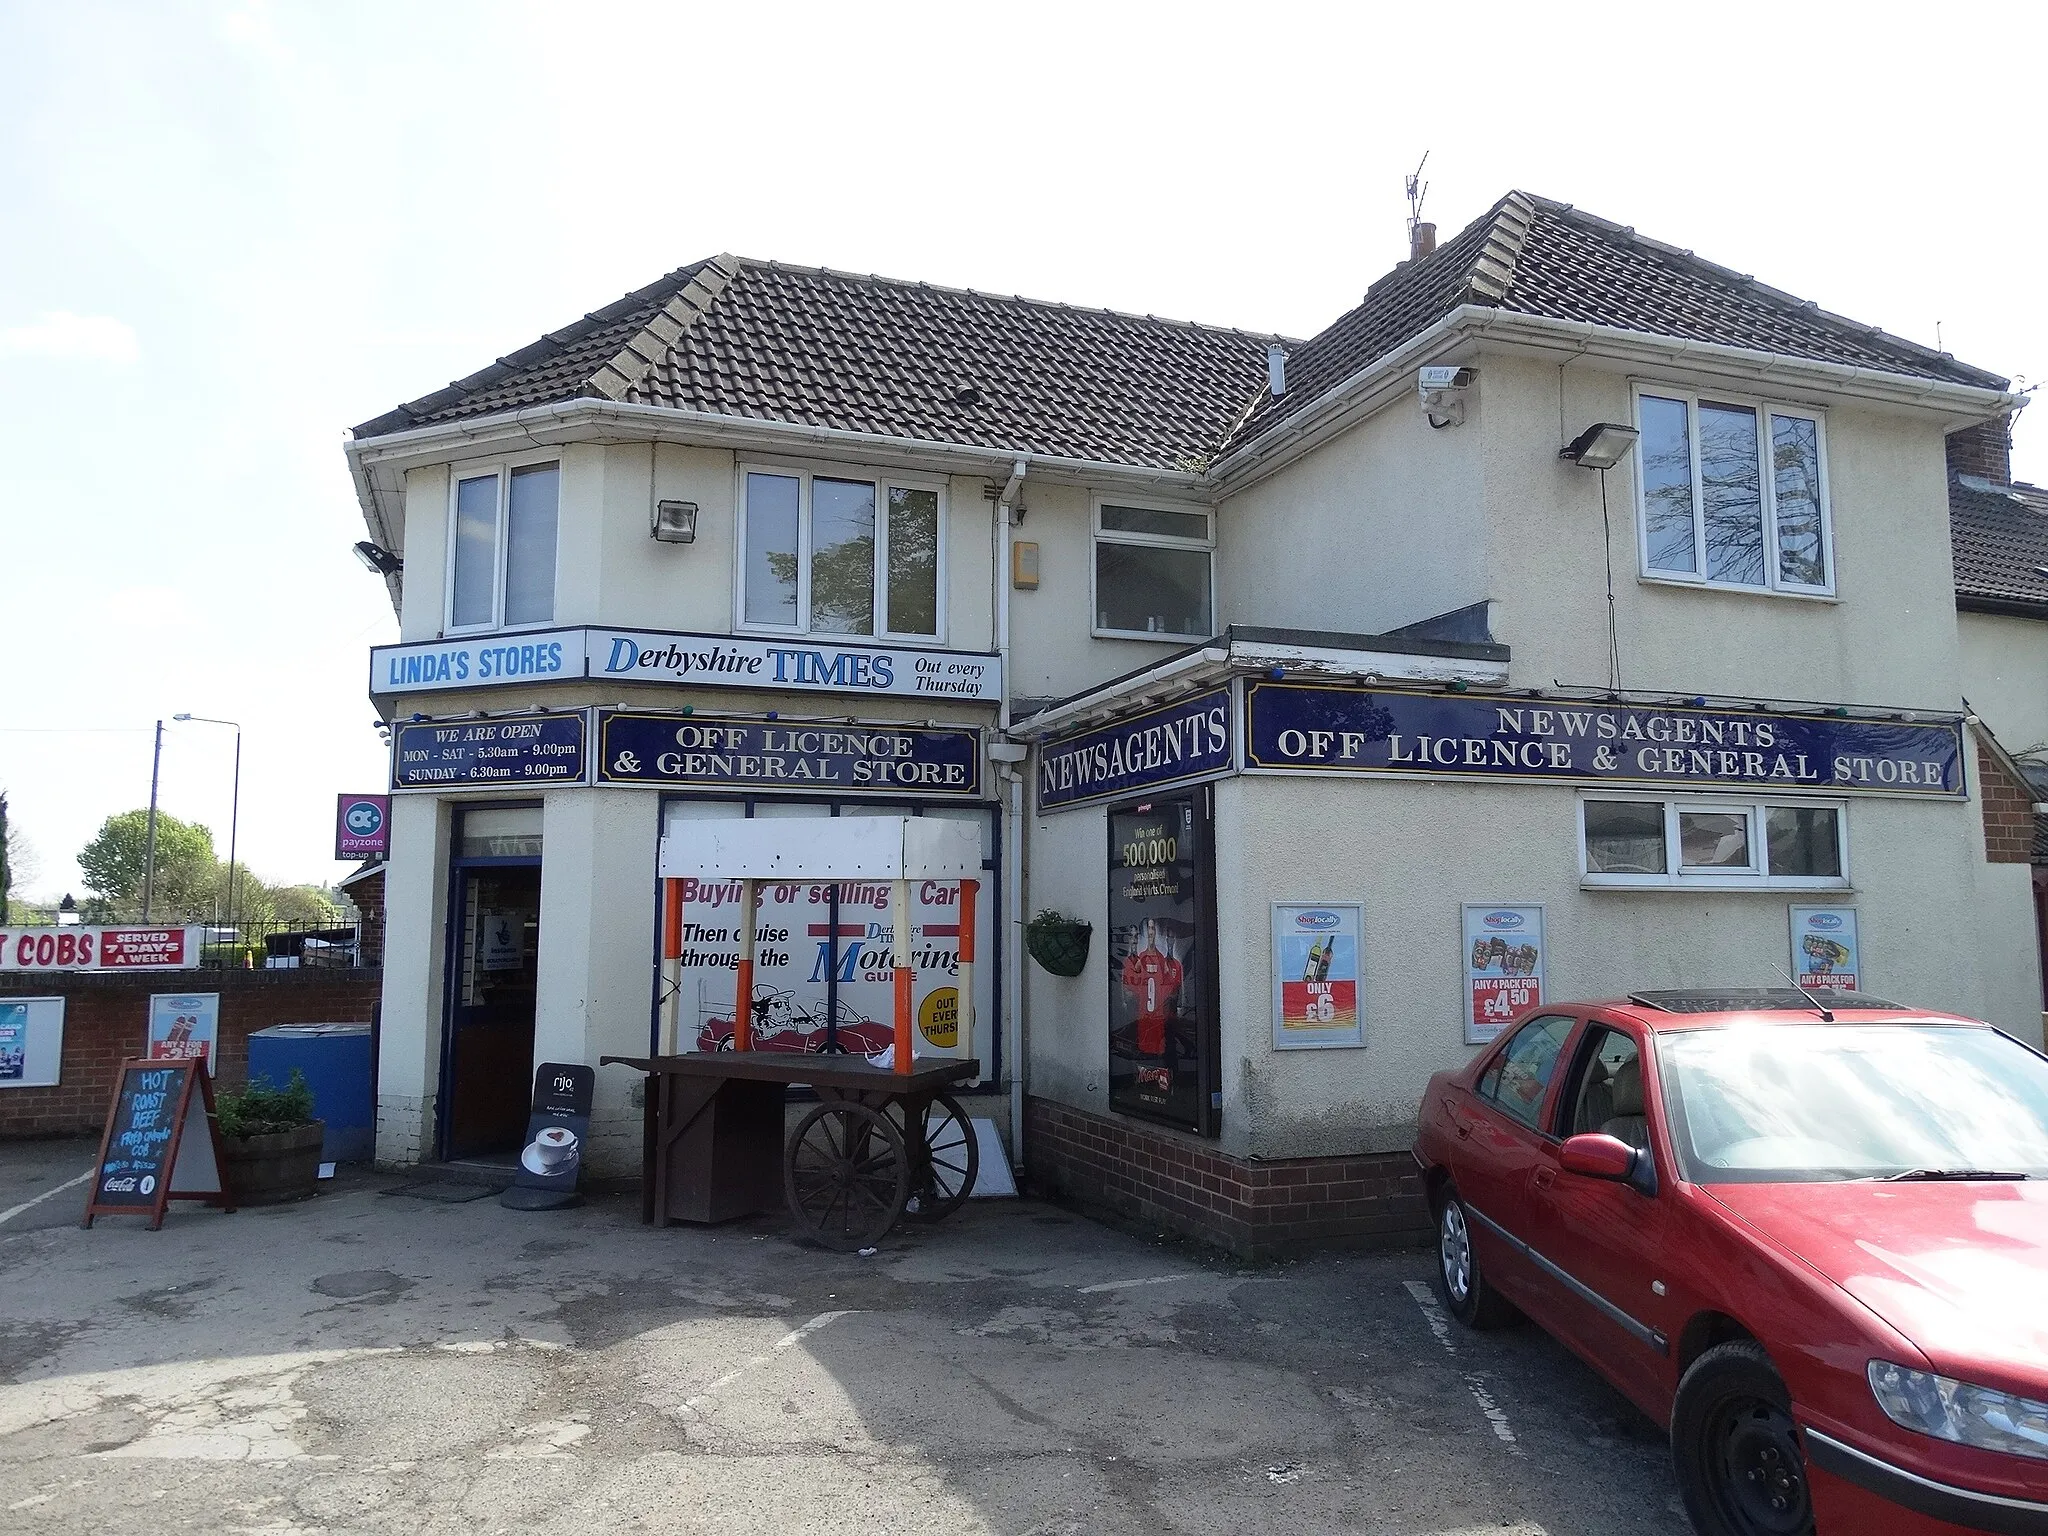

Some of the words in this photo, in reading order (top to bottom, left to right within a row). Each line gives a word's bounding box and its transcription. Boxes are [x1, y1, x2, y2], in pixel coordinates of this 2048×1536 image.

[389, 650, 470, 686] LINDA'S
[479, 642, 562, 677] STORES
[605, 637, 763, 676] Derbyshire
[767, 648, 894, 688] TIMES
[914, 656, 942, 674] Out
[947, 661, 985, 680] every
[915, 675, 984, 698] Thursday
[436, 729, 459, 743] WE
[463, 726, 496, 742] ARE
[501, 723, 543, 739] OPEN
[1496, 707, 1775, 748] NEWSAGENTS
[675, 726, 748, 751] OFF
[762, 729, 914, 758] LICENCE
[1040, 705, 1227, 794] NEWSAGENTS
[403, 749, 429, 762] MON
[442, 748, 466, 761] SAT
[477, 746, 519, 759] 5.30am
[532, 743, 576, 756] 9.00pm
[1278, 730, 1366, 760] OFF
[1387, 735, 1573, 769] LICENCE
[1591, 744, 1618, 772] &
[1636, 746, 1819, 779] GENERAL
[1834, 756, 1944, 786] STORE
[408, 767, 457, 782] SUNDAY
[470, 765, 511, 778] 6.30am
[524, 763, 568, 776] 9.00pm
[613, 750, 642, 774] &
[656, 752, 839, 781] GENERAL
[853, 760, 965, 785] STORE
[342, 839, 383, 848] payzone
[1123, 837, 1176, 868] 500,000
[342, 851, 369, 860] top-up
[774, 885, 801, 904] or
[807, 884, 891, 910] selling
[116, 932, 170, 943] SERVED
[682, 923, 728, 942] Then
[733, 923, 789, 942] cuise
[867, 922, 922, 940] Derbire
[879, 933, 914, 944] TIMS
[17, 933, 94, 966] COBS
[105, 945, 119, 954] 7
[122, 942, 179, 954] DAYS
[115, 954, 126, 964] A
[129, 952, 170, 963] WEEK
[680, 948, 740, 971] throug
[760, 948, 789, 968] the
[865, 972, 918, 982] GUIE
[1474, 980, 1491, 990] ANY
[1492, 980, 1498, 990] 4
[1500, 979, 1520, 989] PACK
[1522, 978, 1538, 989] FOR
[1801, 975, 1816, 984] ANY
[1823, 975, 1840, 984] PACK
[1841, 975, 1854, 984] FOR
[1307, 982, 1332, 994] ONLY
[936, 998, 955, 1010] OUT
[1306, 993, 1335, 1023] £6
[1484, 988, 1530, 1016] £4.50
[924, 1023, 959, 1037] THURS
[141, 1070, 174, 1091] HOT
[131, 1092, 167, 1111] ROAST
[131, 1109, 161, 1130] BEEF
